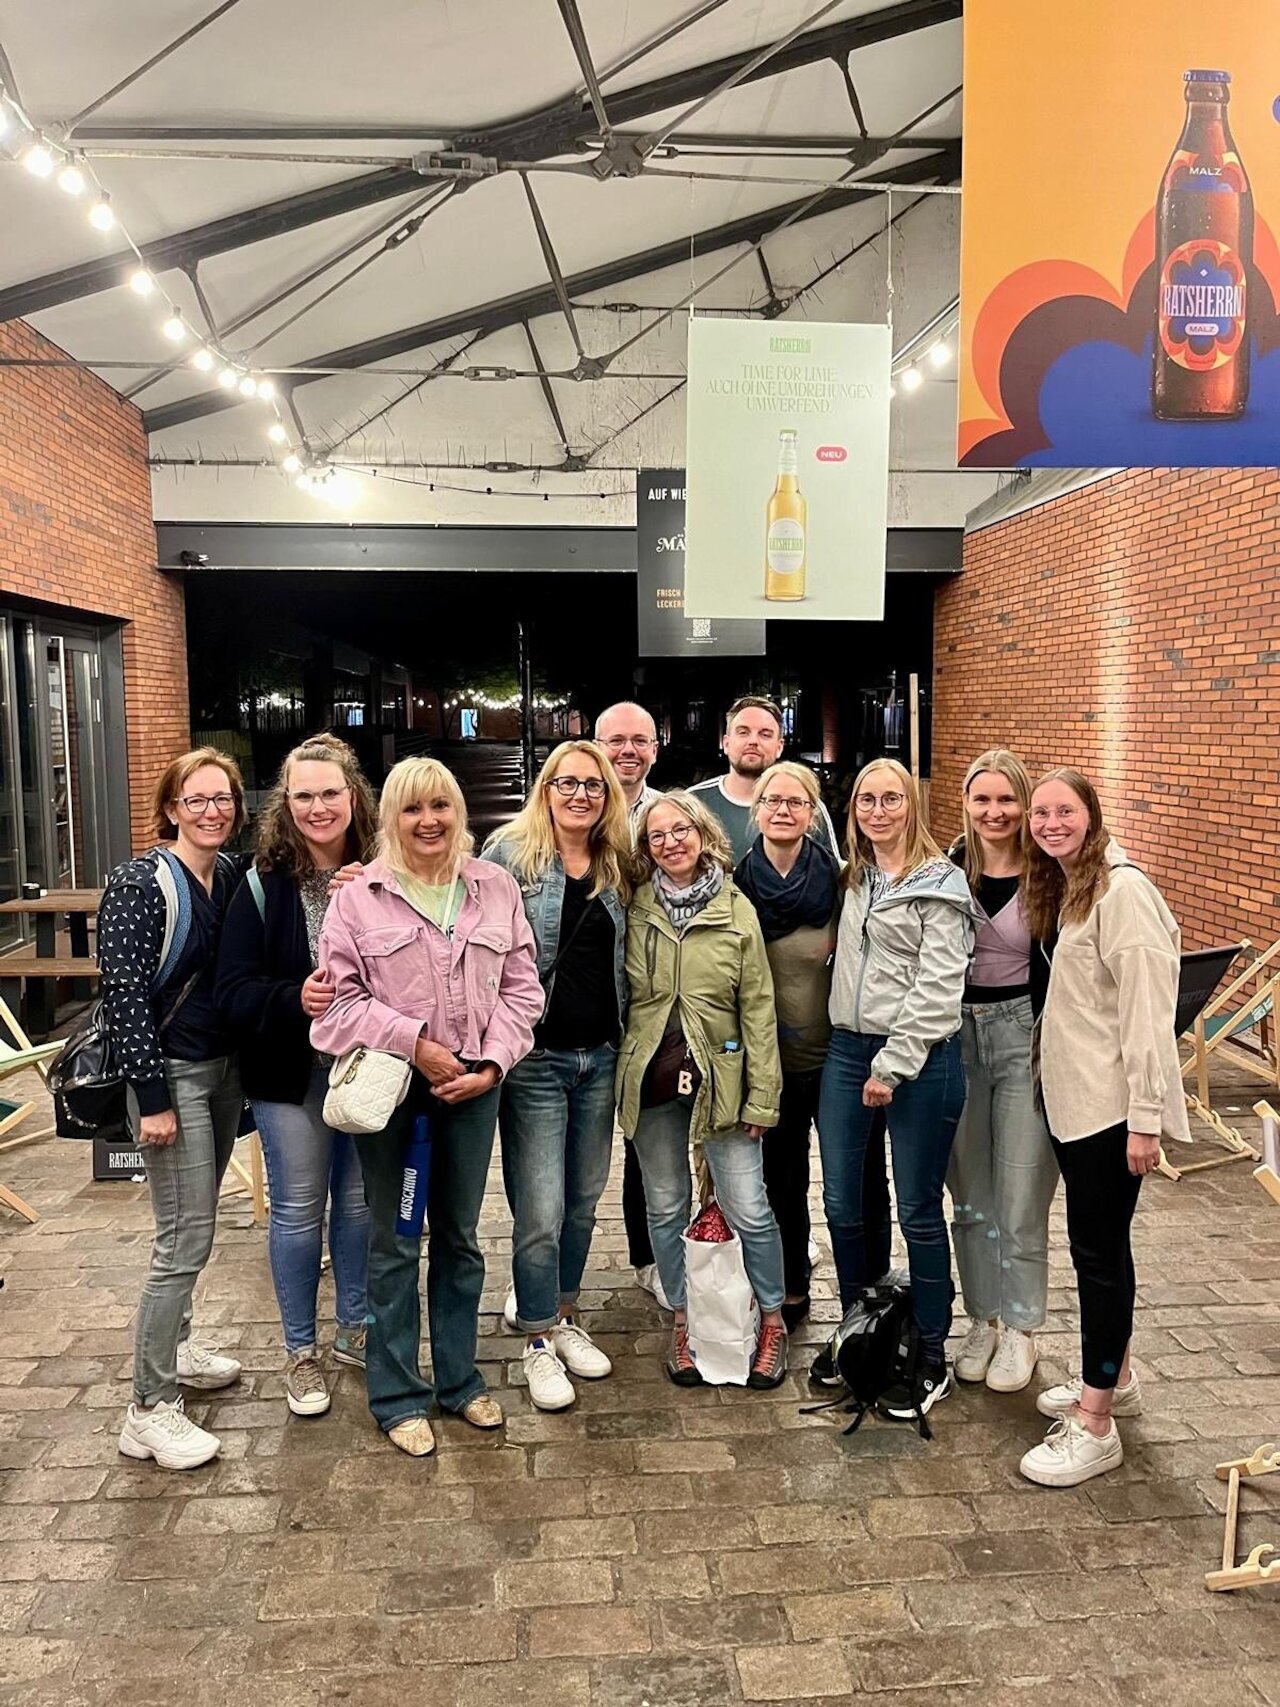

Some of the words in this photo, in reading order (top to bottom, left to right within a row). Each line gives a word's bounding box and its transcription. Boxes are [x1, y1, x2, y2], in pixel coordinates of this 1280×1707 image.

[1189, 167, 1222, 176] MALZ
[1163, 285, 1243, 317] RATSHERRN
[1190, 325, 1215, 333] MALZ
[741, 364, 773, 380] TIME
[777, 366, 801, 381] FOR
[705, 379, 739, 395] AUCH
[741, 381, 776, 396] OHNE
[778, 382, 873, 399] UMDREHUNGEN
[821, 450, 843, 459] NEU
[648, 488, 668, 500] AUF
[656, 588, 681, 598] FRISCH
[678, 1070, 693, 1095] B
[400, 1167, 418, 1221] MOSCHINO
